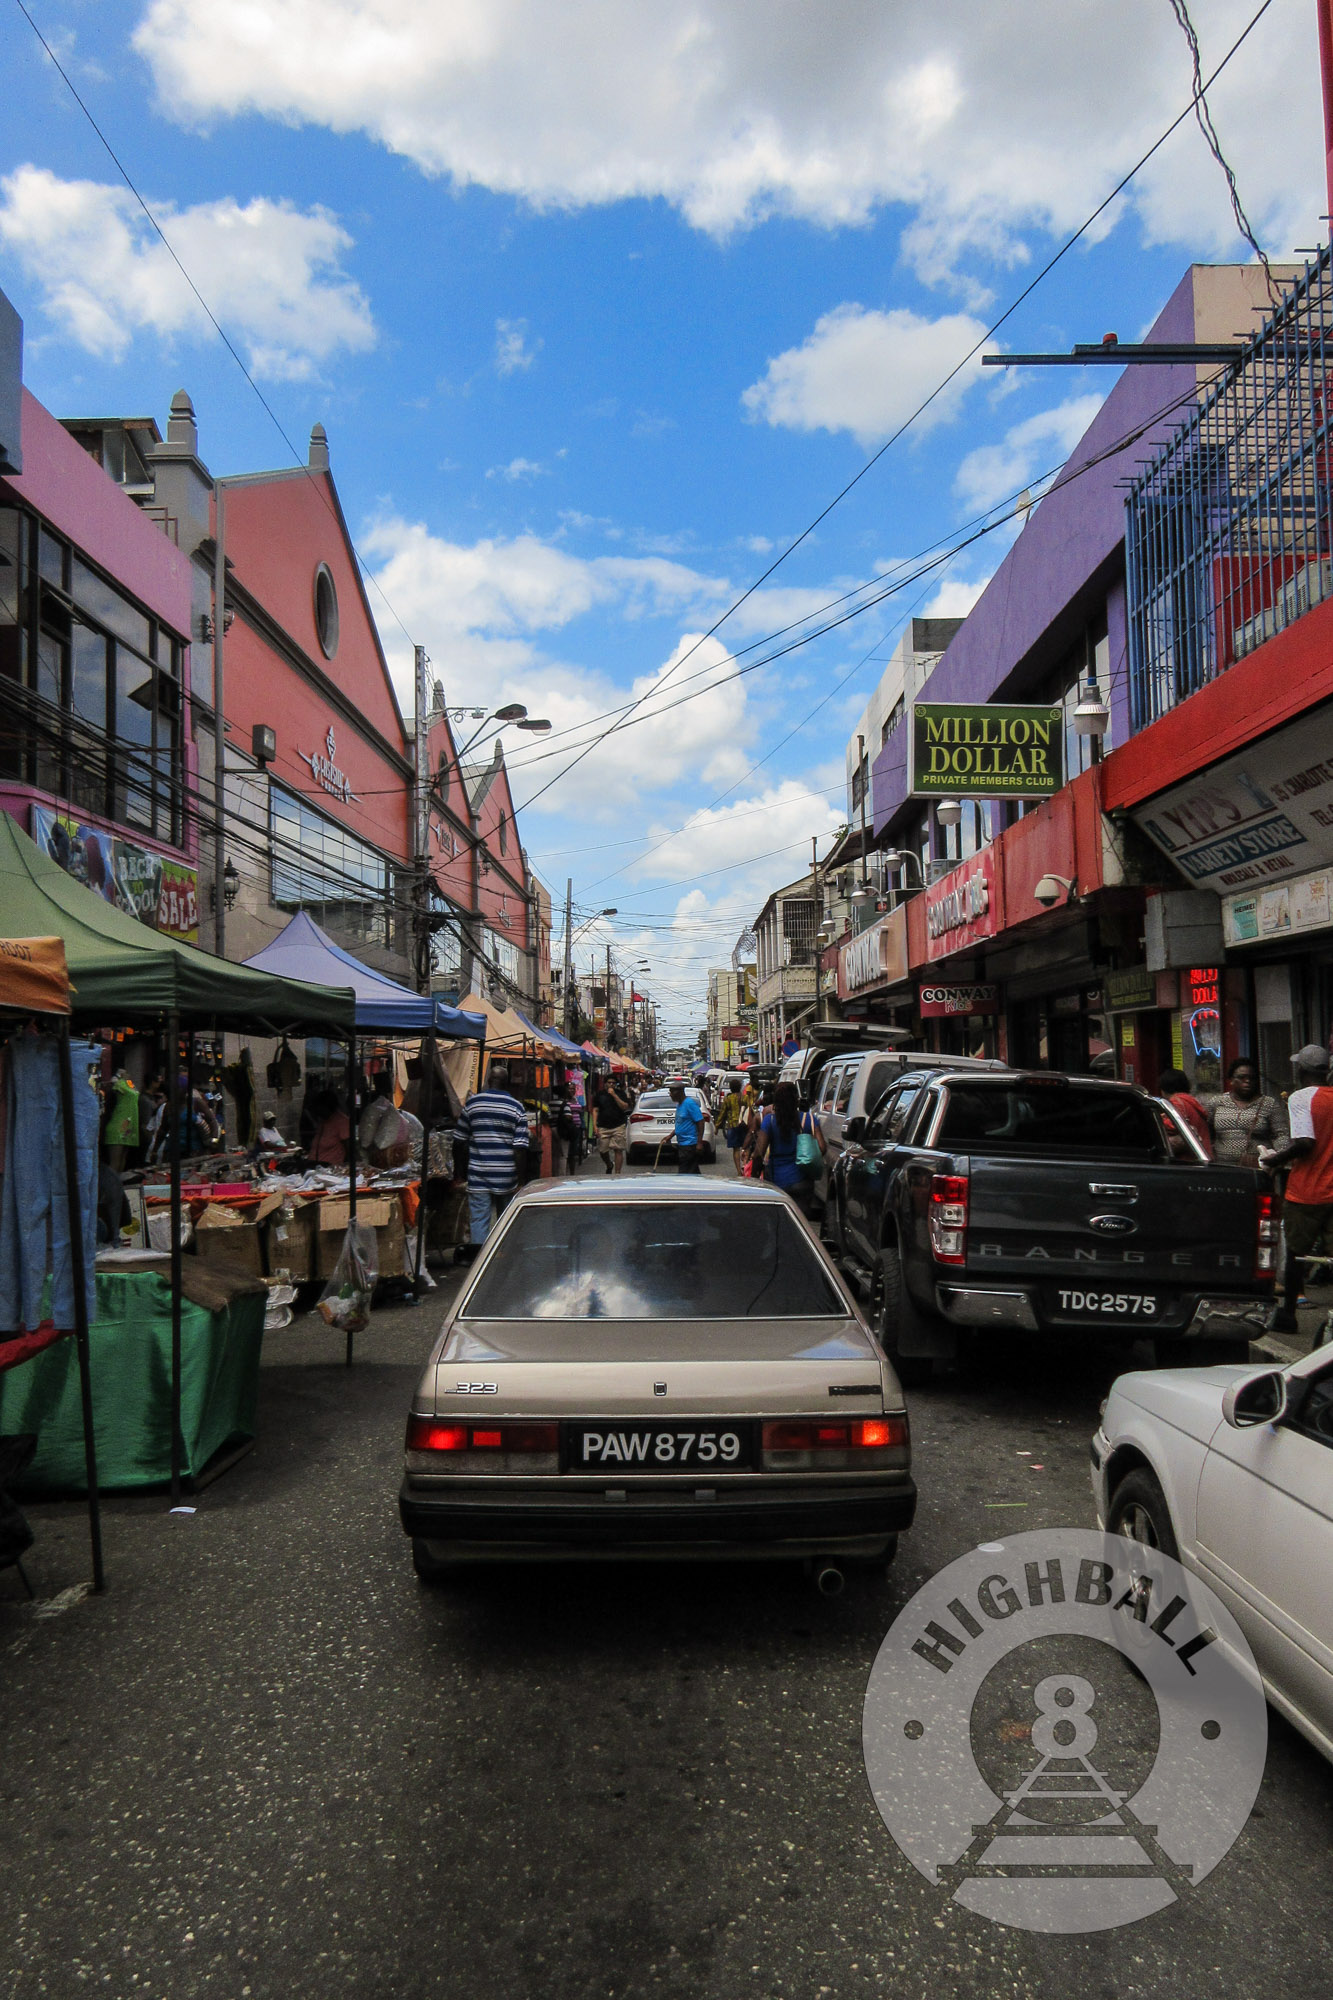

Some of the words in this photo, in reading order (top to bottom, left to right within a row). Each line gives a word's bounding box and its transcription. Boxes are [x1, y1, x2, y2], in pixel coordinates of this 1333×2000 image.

[925, 717, 1051, 745] MILLION
[928, 746, 1048, 774] DOLLAR
[923, 775, 967, 784] PRIVATE
[971, 776, 1022, 785] MEMBERS
[1026, 777, 1054, 785] CLUB
[1283, 763, 1329, 796] CHARLOTTE
[1180, 841, 1245, 877] VARIETY
[1239, 818, 1301, 855] STORE
[118, 855, 162, 881] BACK
[1219, 866, 1259, 885] WHOLESALE
[1263, 855, 1294, 872] RETAIL
[115, 888, 157, 915] SCHOOL
[133, 881, 144, 895] TO
[159, 891, 198, 931] SALE
[922, 987, 995, 1003] CONWAY
[980, 1244, 1241, 1267] RANGER
[1058, 1290, 1156, 1315] TDC2575
[457, 1382, 498, 1394] 323
[582, 1432, 740, 1462] PAW8759
